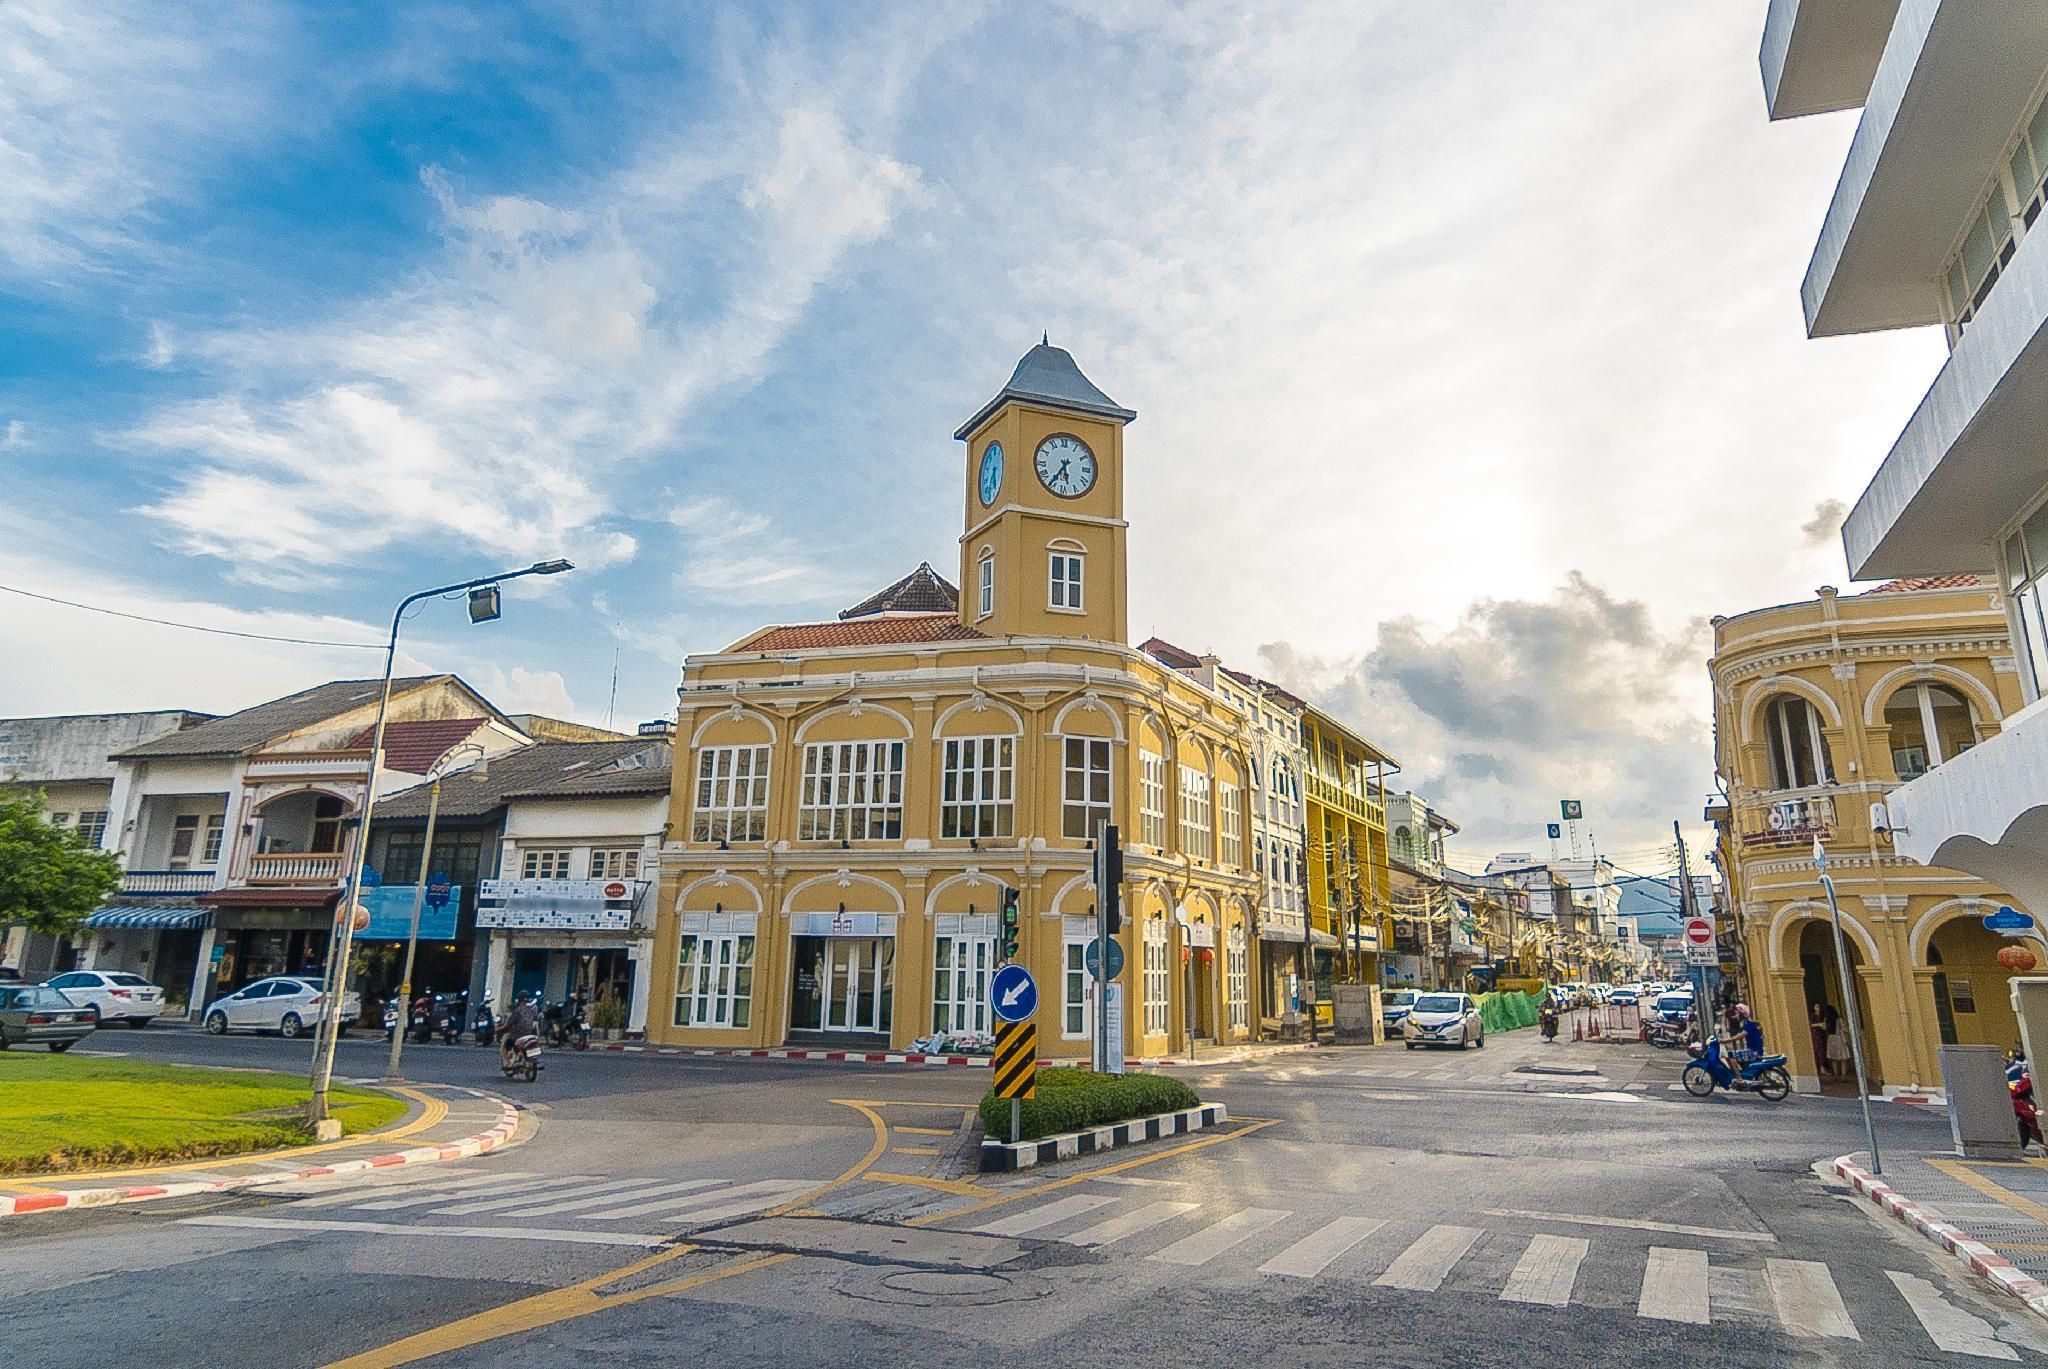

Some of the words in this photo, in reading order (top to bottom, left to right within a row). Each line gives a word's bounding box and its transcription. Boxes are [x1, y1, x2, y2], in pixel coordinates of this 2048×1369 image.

[1060, 438, 1069, 448] XII
[1041, 448, 1050, 457] X
[1072, 443, 1079, 453] I
[1081, 466, 1090, 474] III
[1059, 484, 1068, 495] VI
[1072, 484, 1080, 493] V
